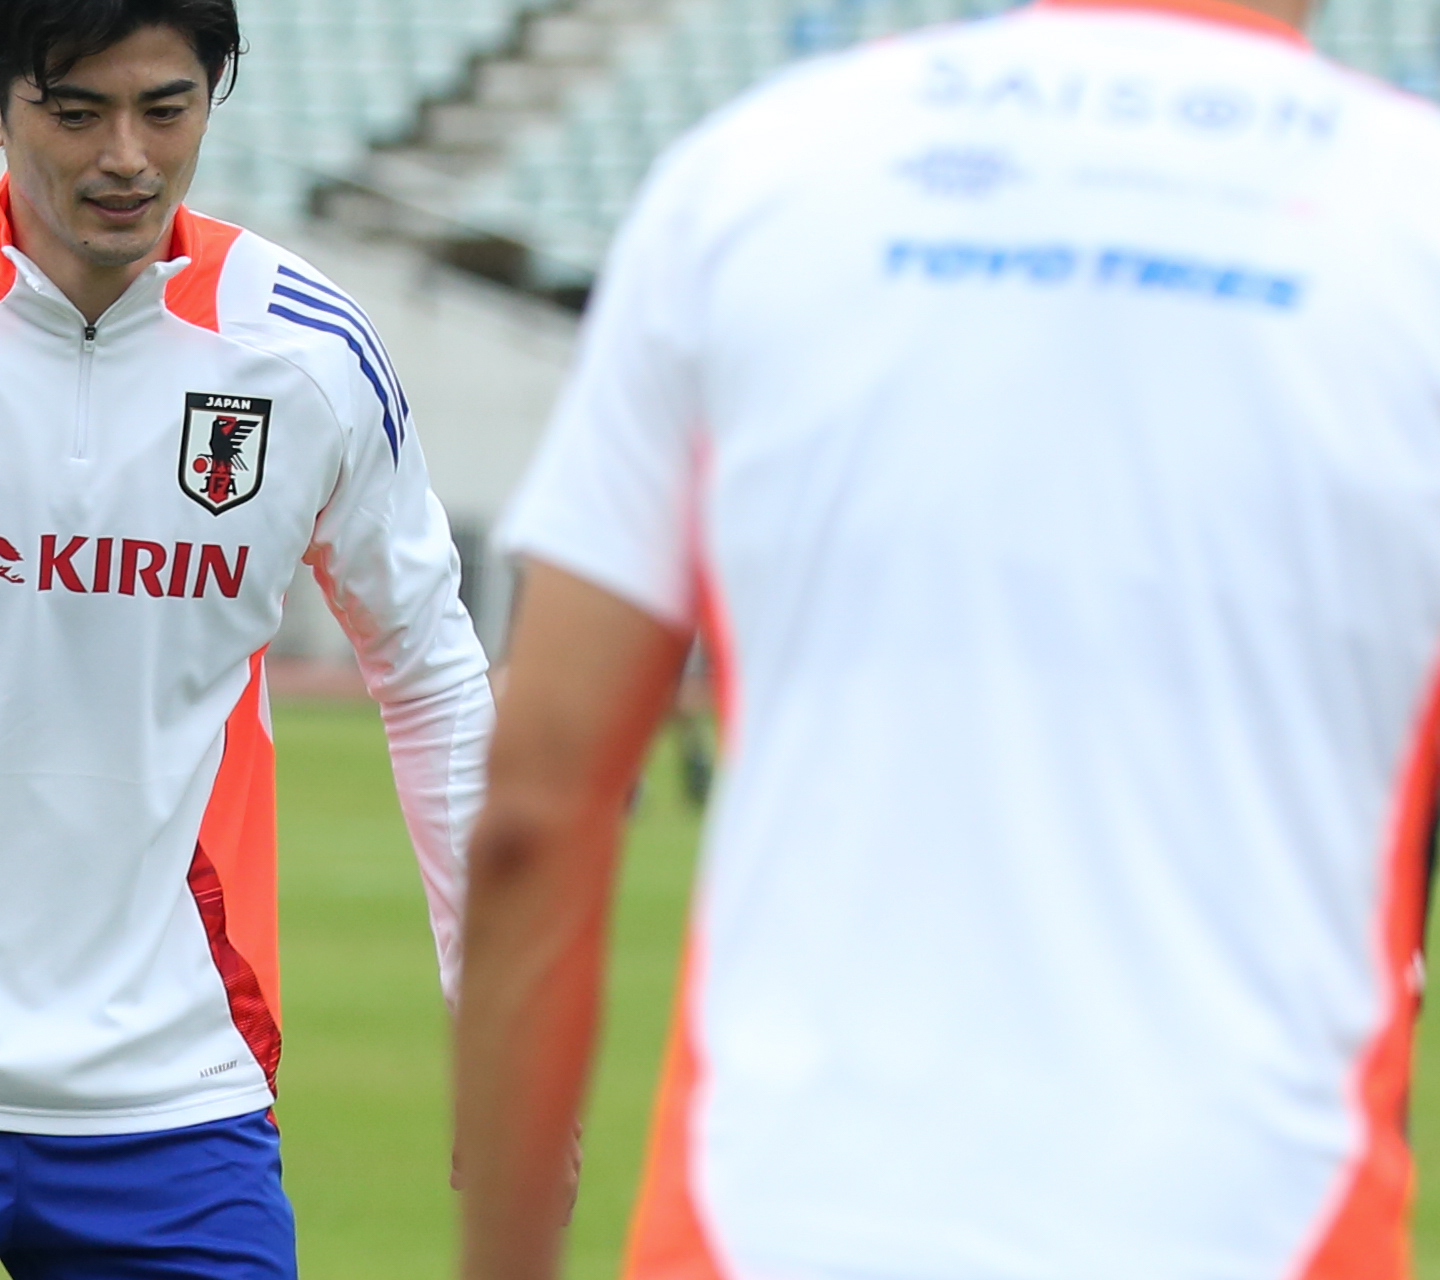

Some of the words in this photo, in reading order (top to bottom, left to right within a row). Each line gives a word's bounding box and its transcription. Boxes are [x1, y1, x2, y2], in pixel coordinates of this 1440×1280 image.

[206, 397, 251, 410] JAPAN
[199, 475, 237, 496] JFA
[38, 534, 249, 598] KIRIN
